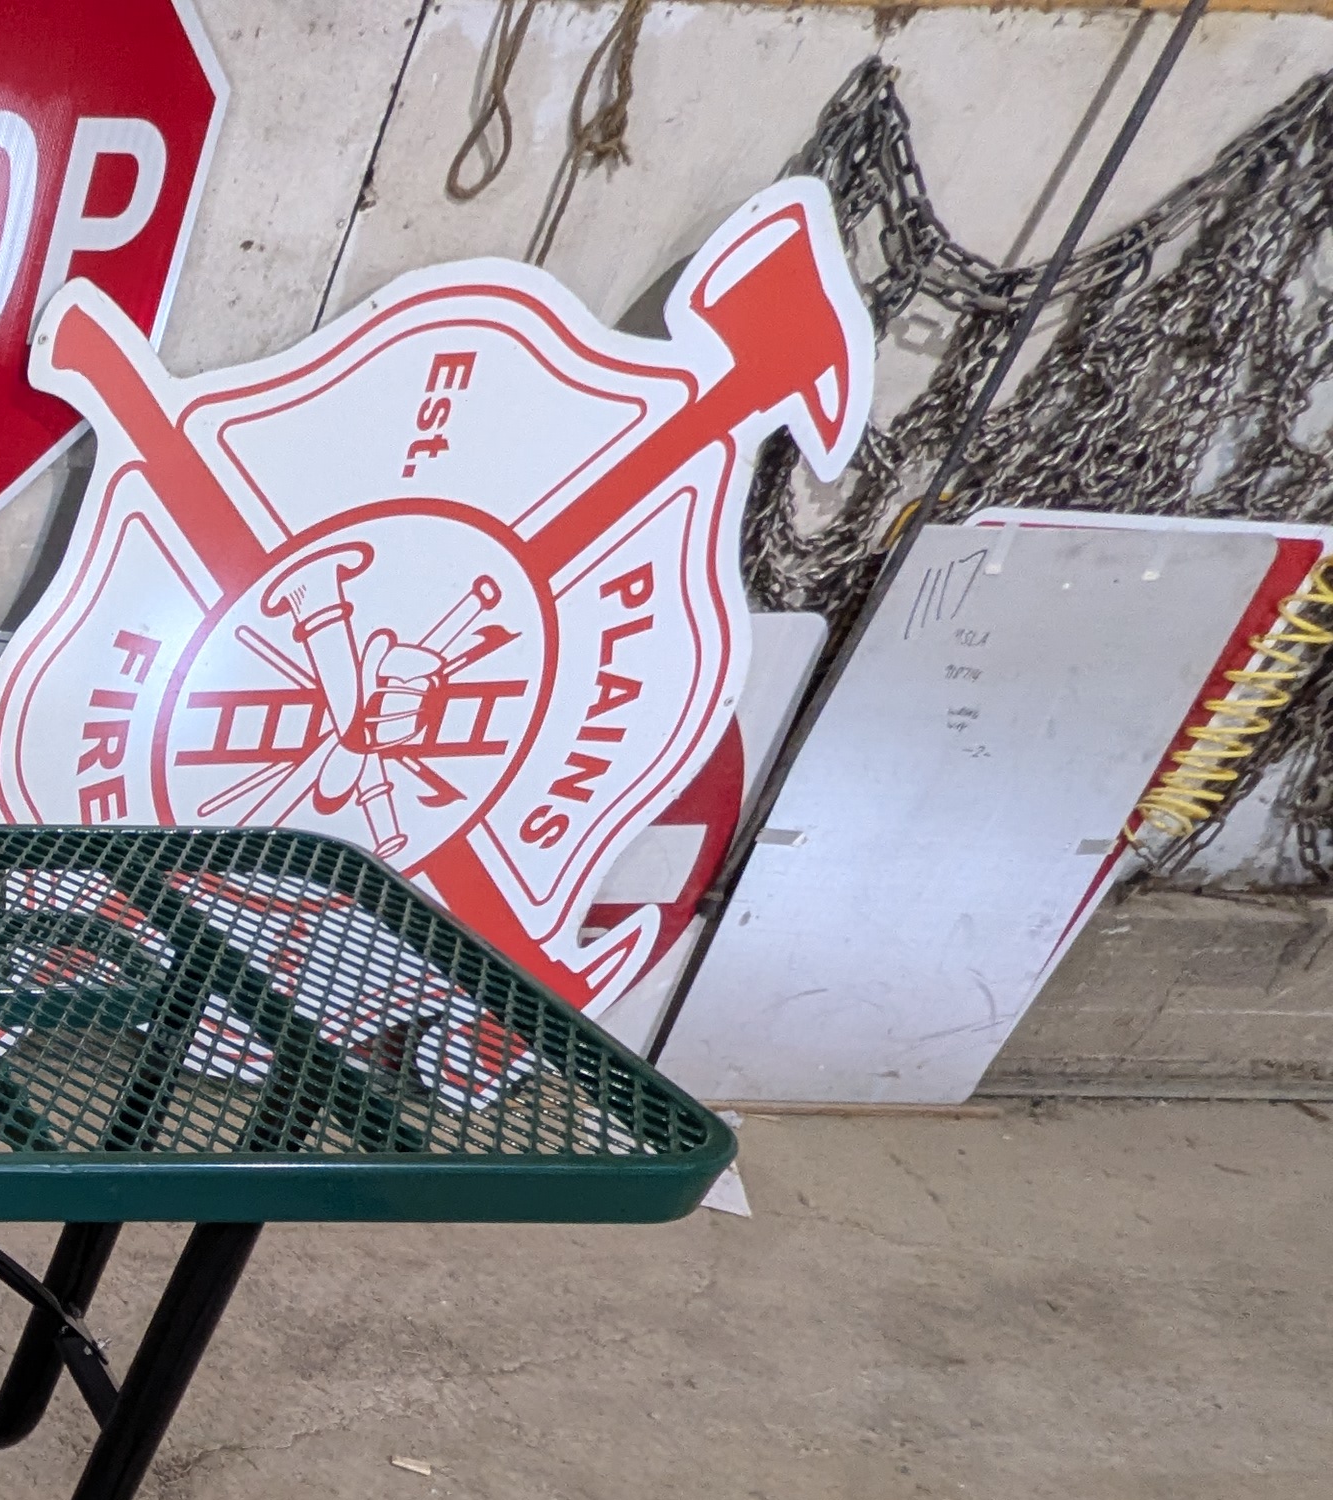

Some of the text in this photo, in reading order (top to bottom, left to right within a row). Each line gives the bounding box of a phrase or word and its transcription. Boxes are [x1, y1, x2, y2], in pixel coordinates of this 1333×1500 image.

[400, 350, 476, 480] Est.
[76, 629, 162, 824] FIRE
[519, 558, 654, 850] PLAINS
